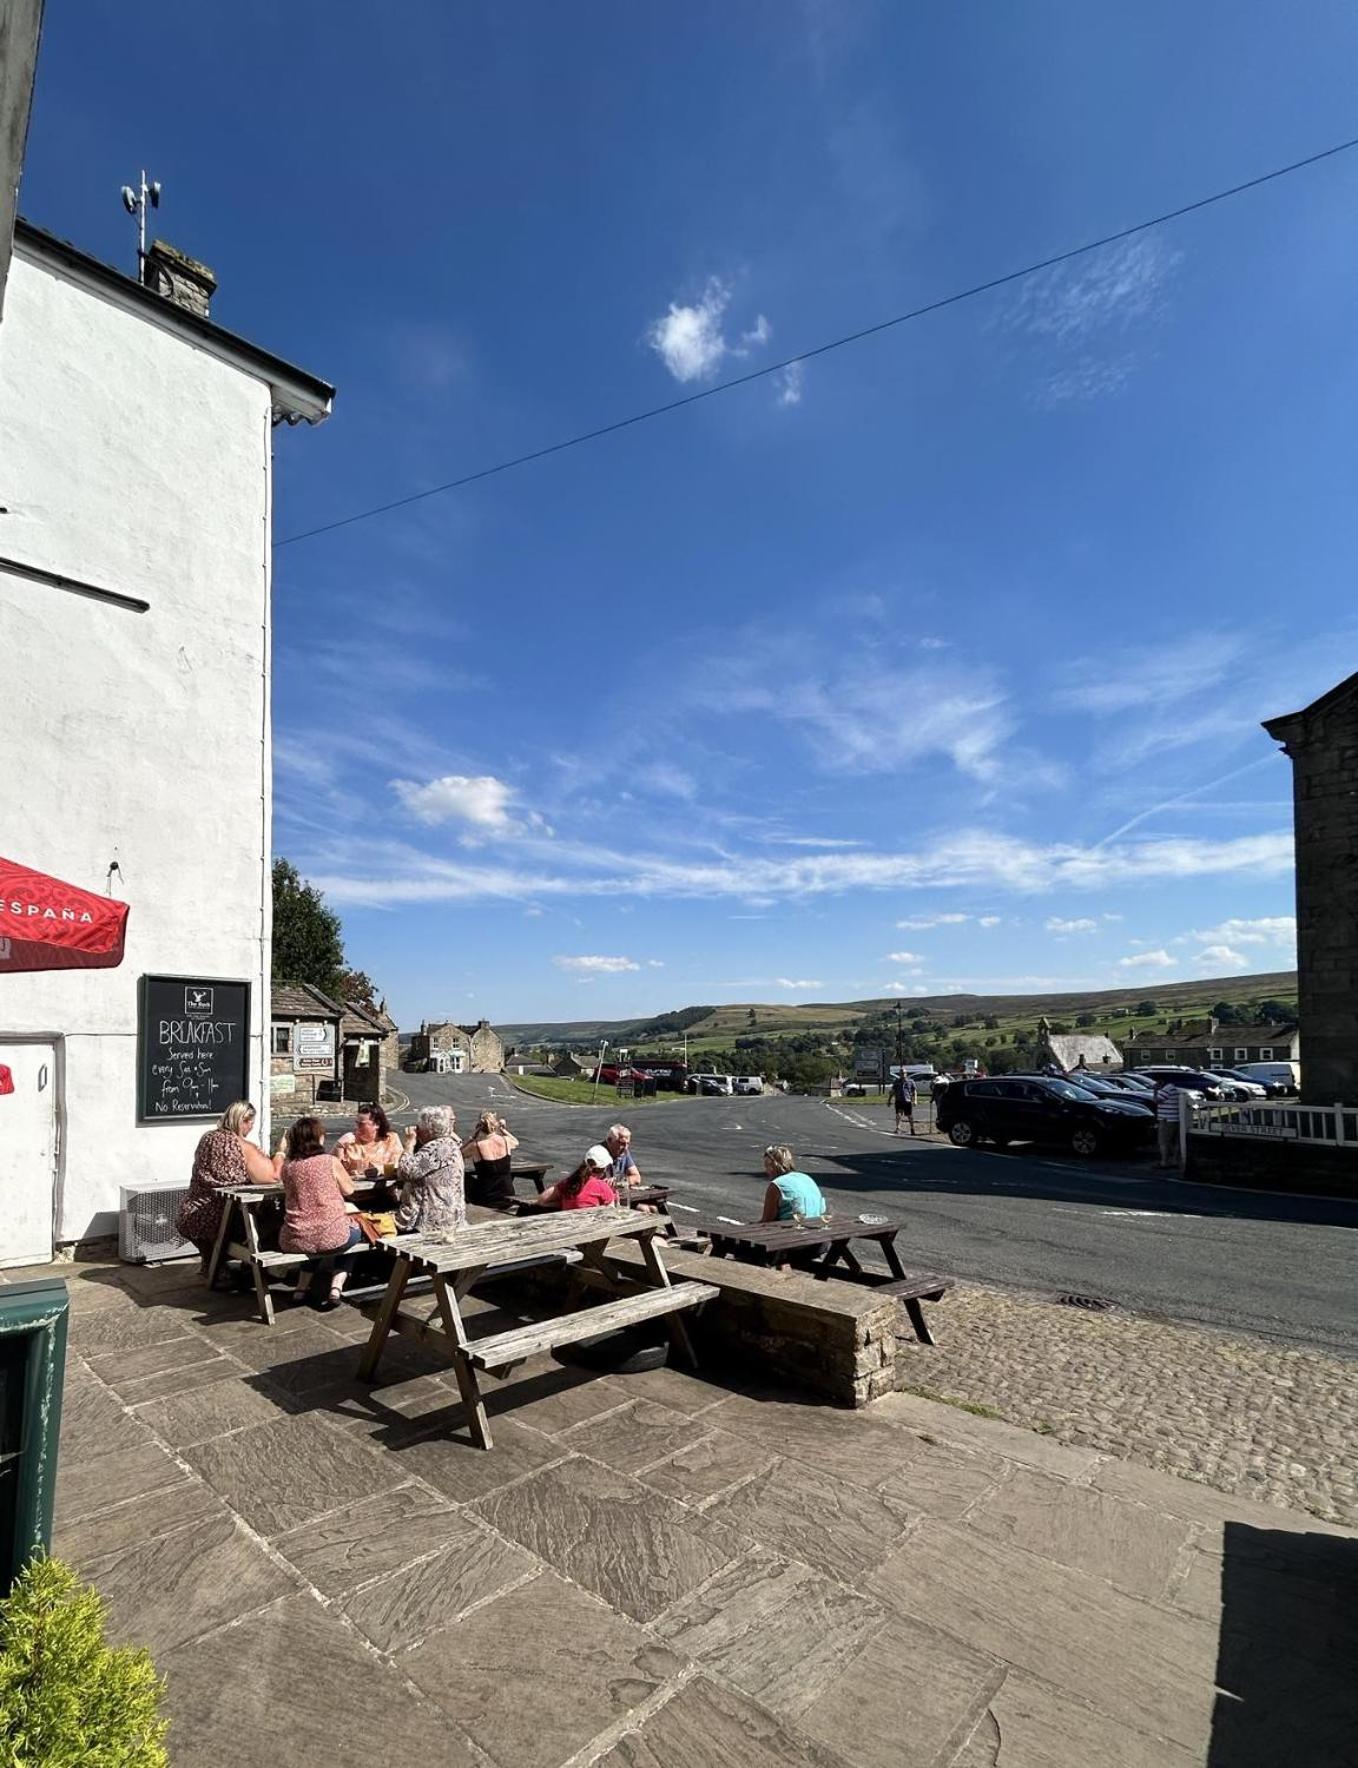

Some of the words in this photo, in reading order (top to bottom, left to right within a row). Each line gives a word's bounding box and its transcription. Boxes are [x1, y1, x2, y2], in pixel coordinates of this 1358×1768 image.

[0, 899, 93, 923] ESPAÑA
[159, 1020, 237, 1044] BREAKFAST
[166, 1047, 194, 1060] Served
[197, 1047, 214, 1060] here
[152, 1064, 173, 1079] every
[161, 1079, 180, 1098] from
[155, 1101, 168, 1112] No
